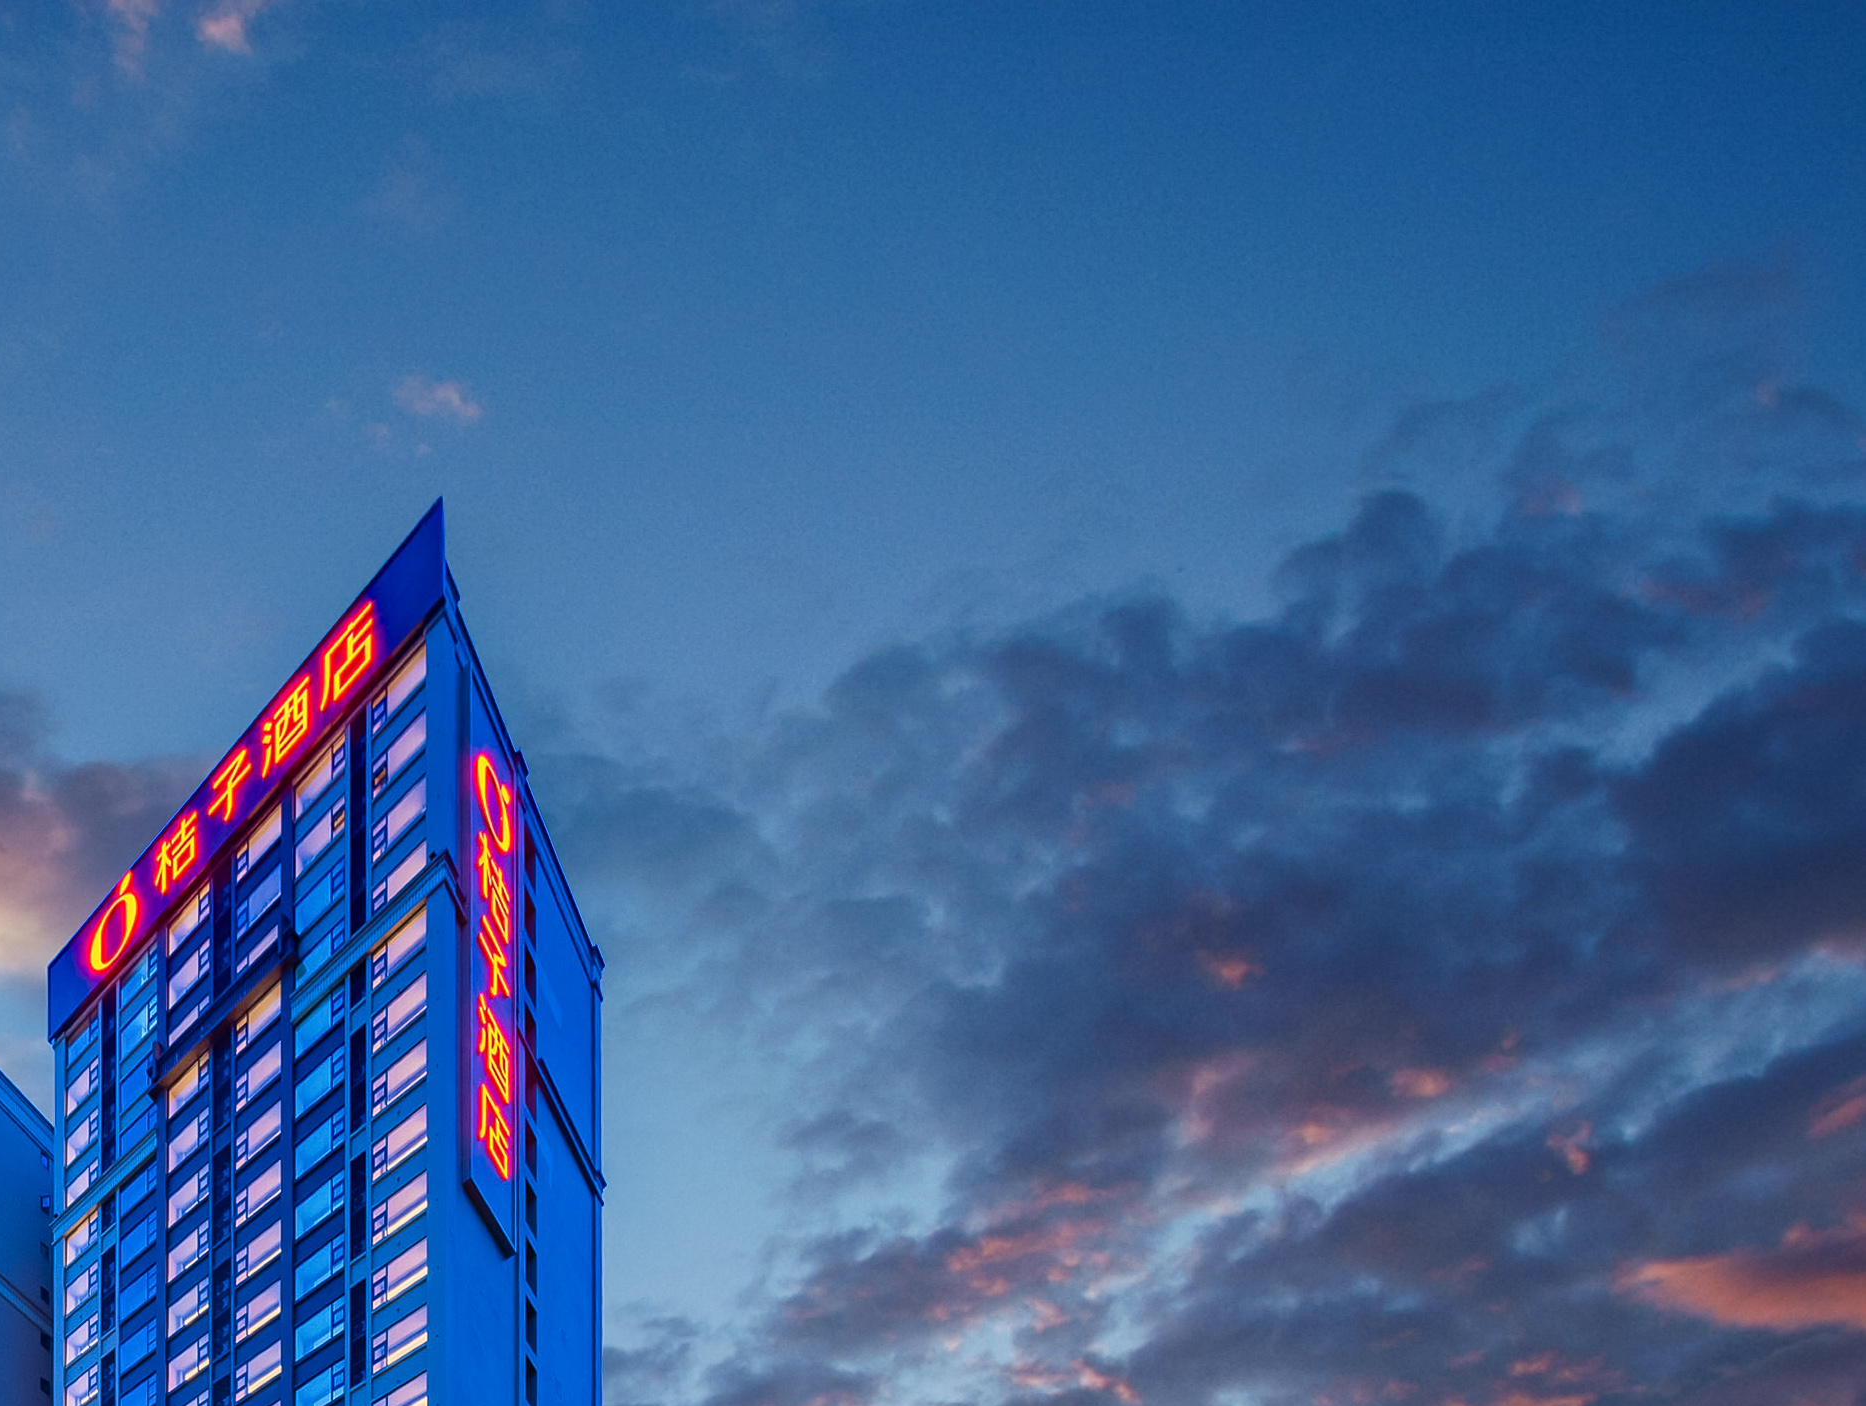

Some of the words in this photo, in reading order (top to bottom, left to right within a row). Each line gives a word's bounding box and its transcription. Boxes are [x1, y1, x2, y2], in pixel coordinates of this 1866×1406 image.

[154, 601, 374, 895] 桔子酒店
[477, 831, 511, 1181] 桔子酒店
